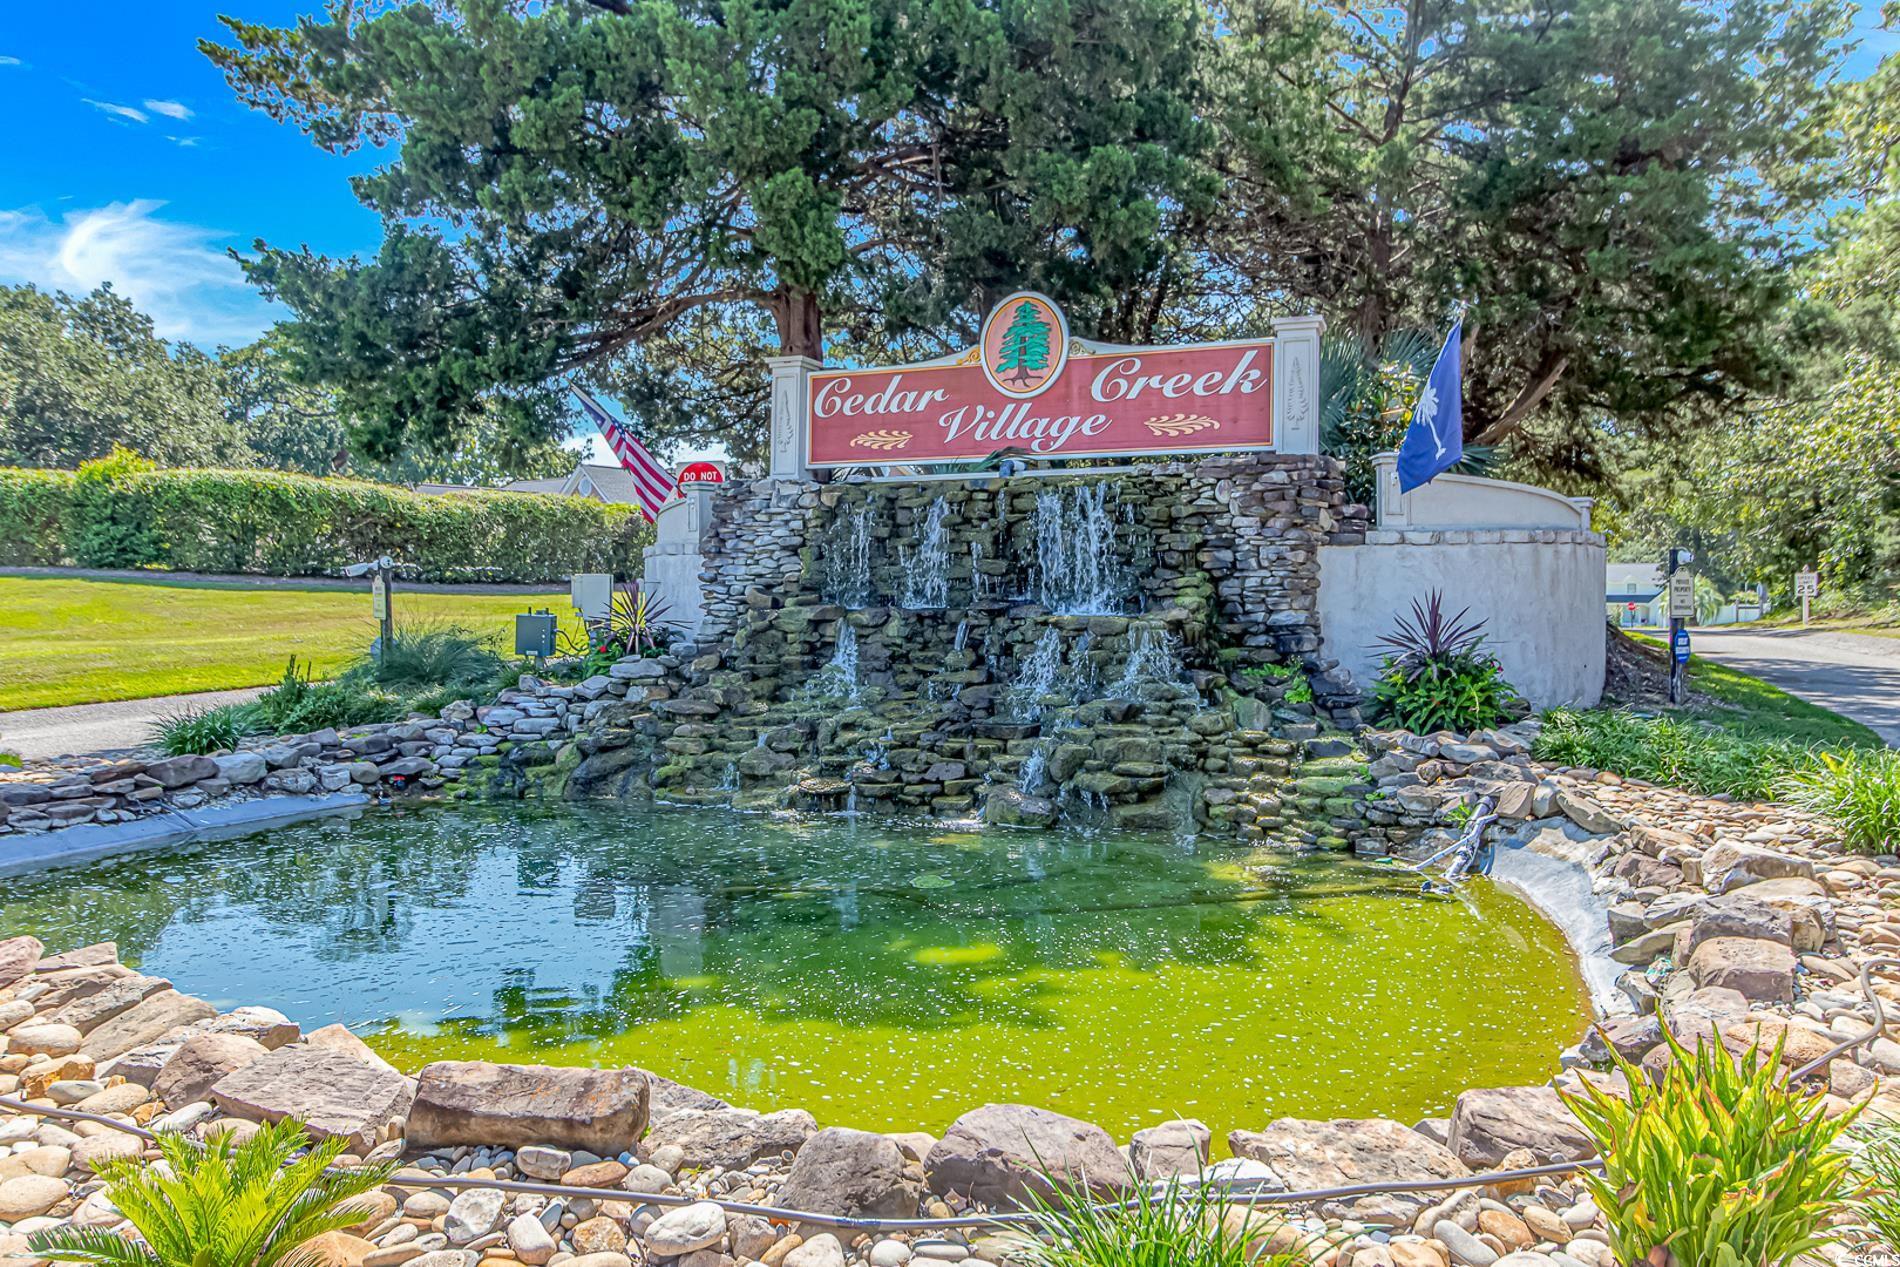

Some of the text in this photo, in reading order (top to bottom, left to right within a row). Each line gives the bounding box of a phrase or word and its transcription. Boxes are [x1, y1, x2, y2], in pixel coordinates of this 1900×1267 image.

[814, 350, 1268, 418] Cedar Creek
[937, 403, 1112, 452] Village
[683, 471, 717, 481] DO NOT
[1797, 585, 1815, 594] 25
